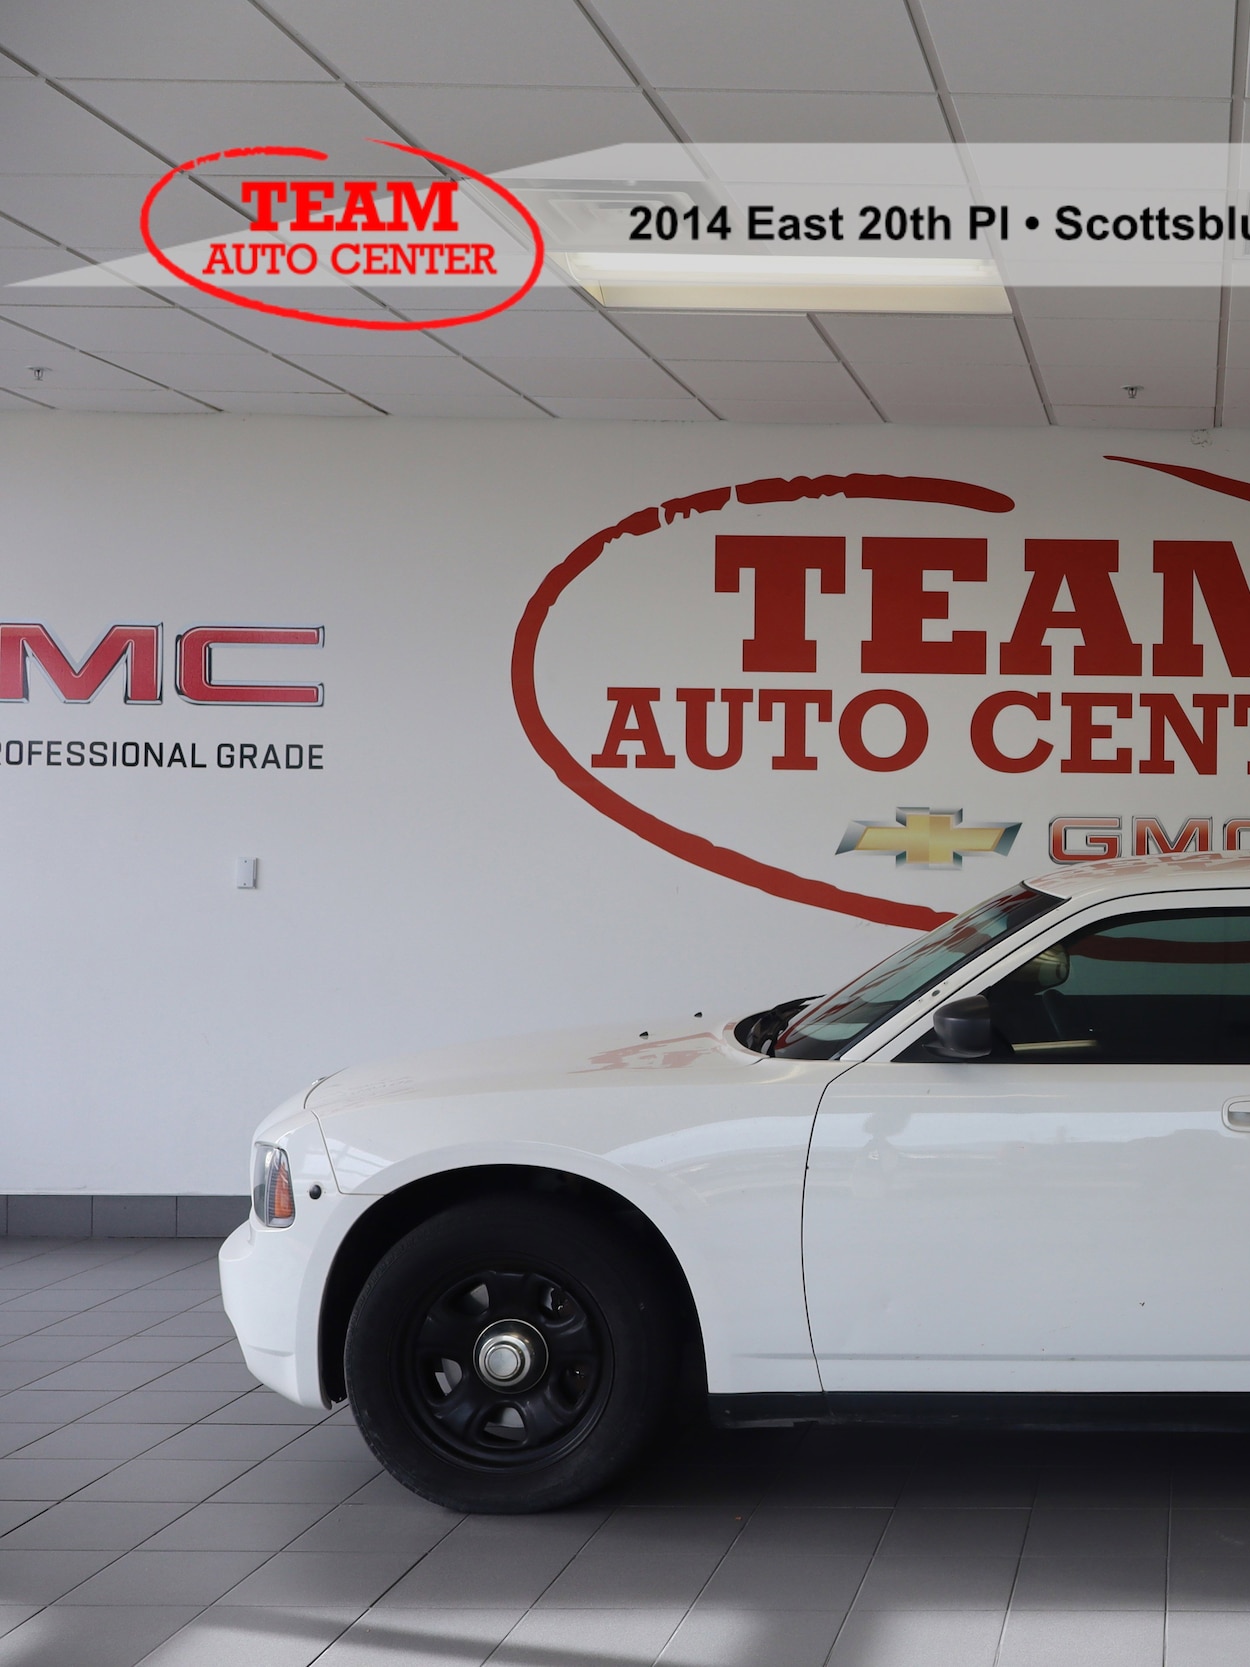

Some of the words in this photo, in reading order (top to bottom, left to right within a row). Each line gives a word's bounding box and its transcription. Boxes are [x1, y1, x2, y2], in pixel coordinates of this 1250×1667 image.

[0, 740, 207, 769] OFESSIONAL
[216, 742, 324, 770] GRADE
[591, 686, 930, 773] AUTO
